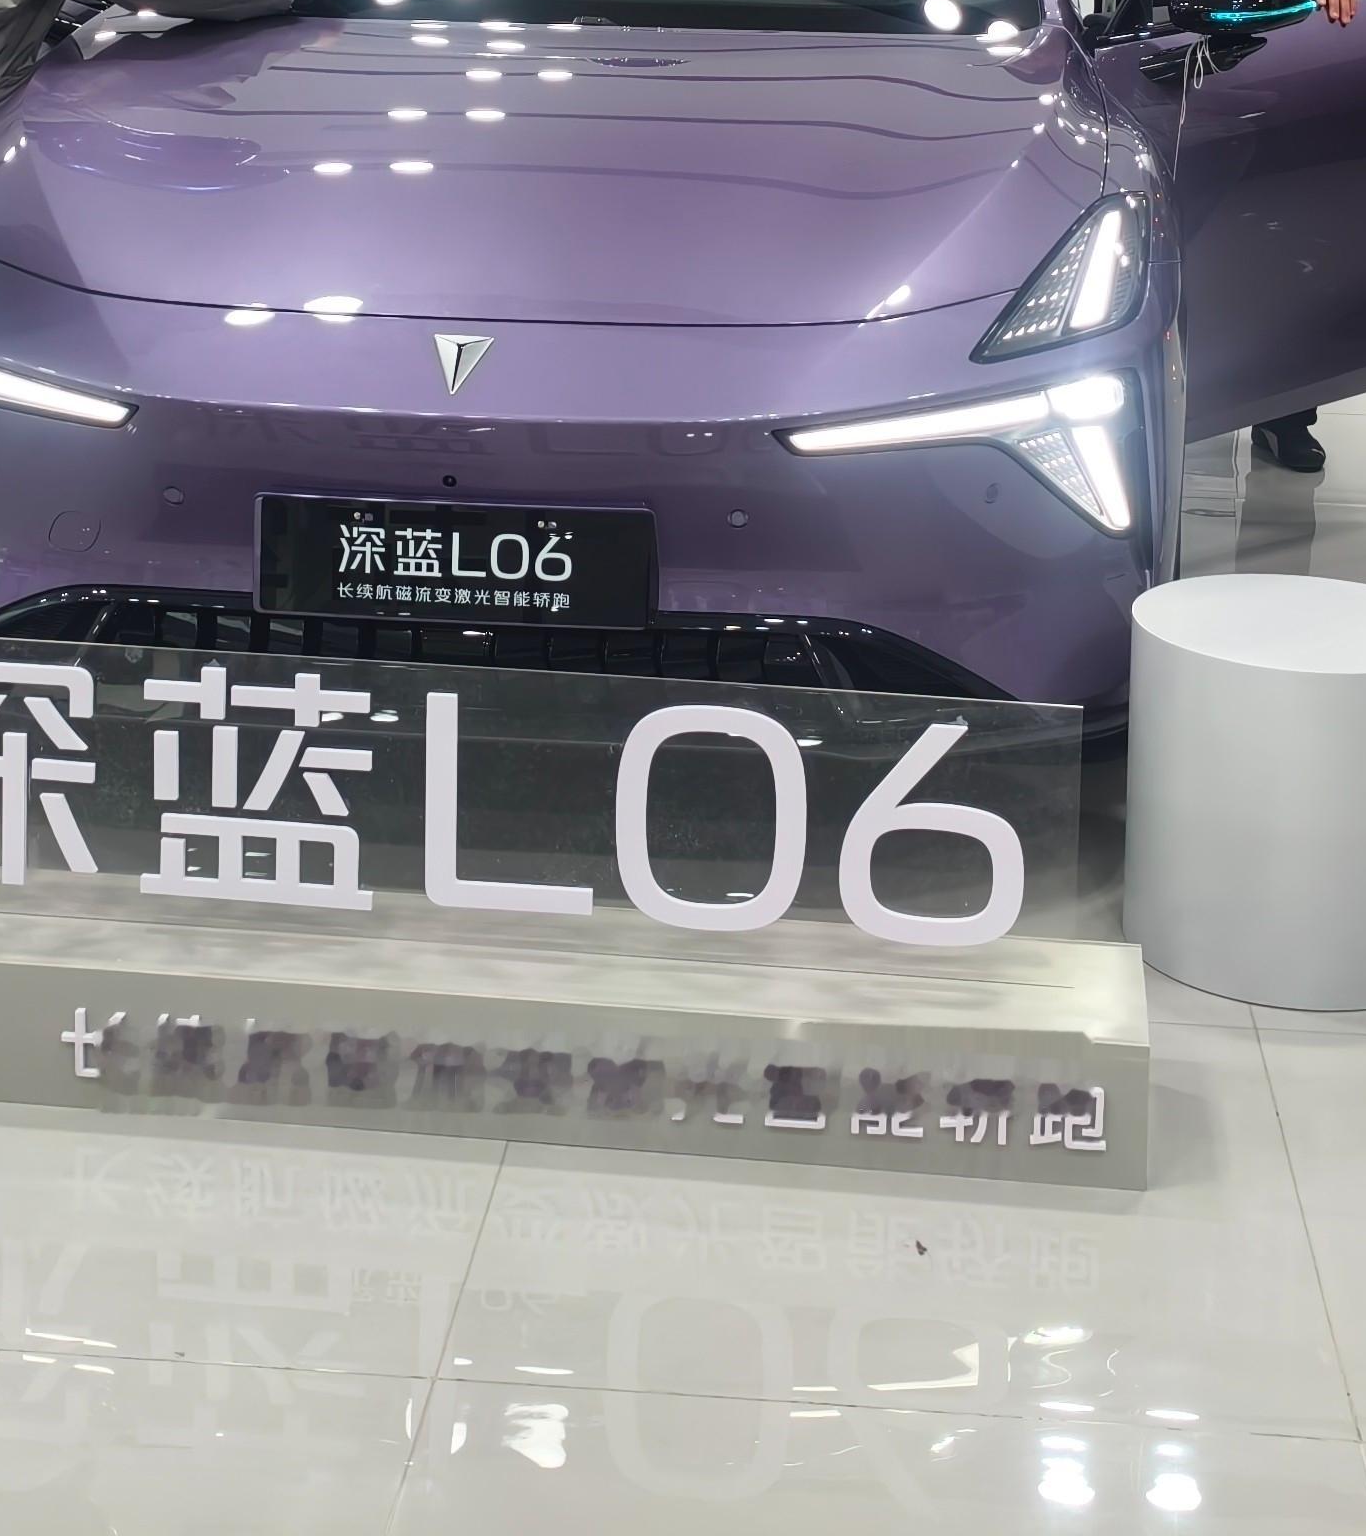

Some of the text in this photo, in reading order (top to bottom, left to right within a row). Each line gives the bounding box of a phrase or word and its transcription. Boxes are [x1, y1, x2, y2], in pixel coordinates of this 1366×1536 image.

[337, 523, 573, 583] 深蓝L06
[336, 581, 571, 610] 长续航磁流变激光智能轿跑
